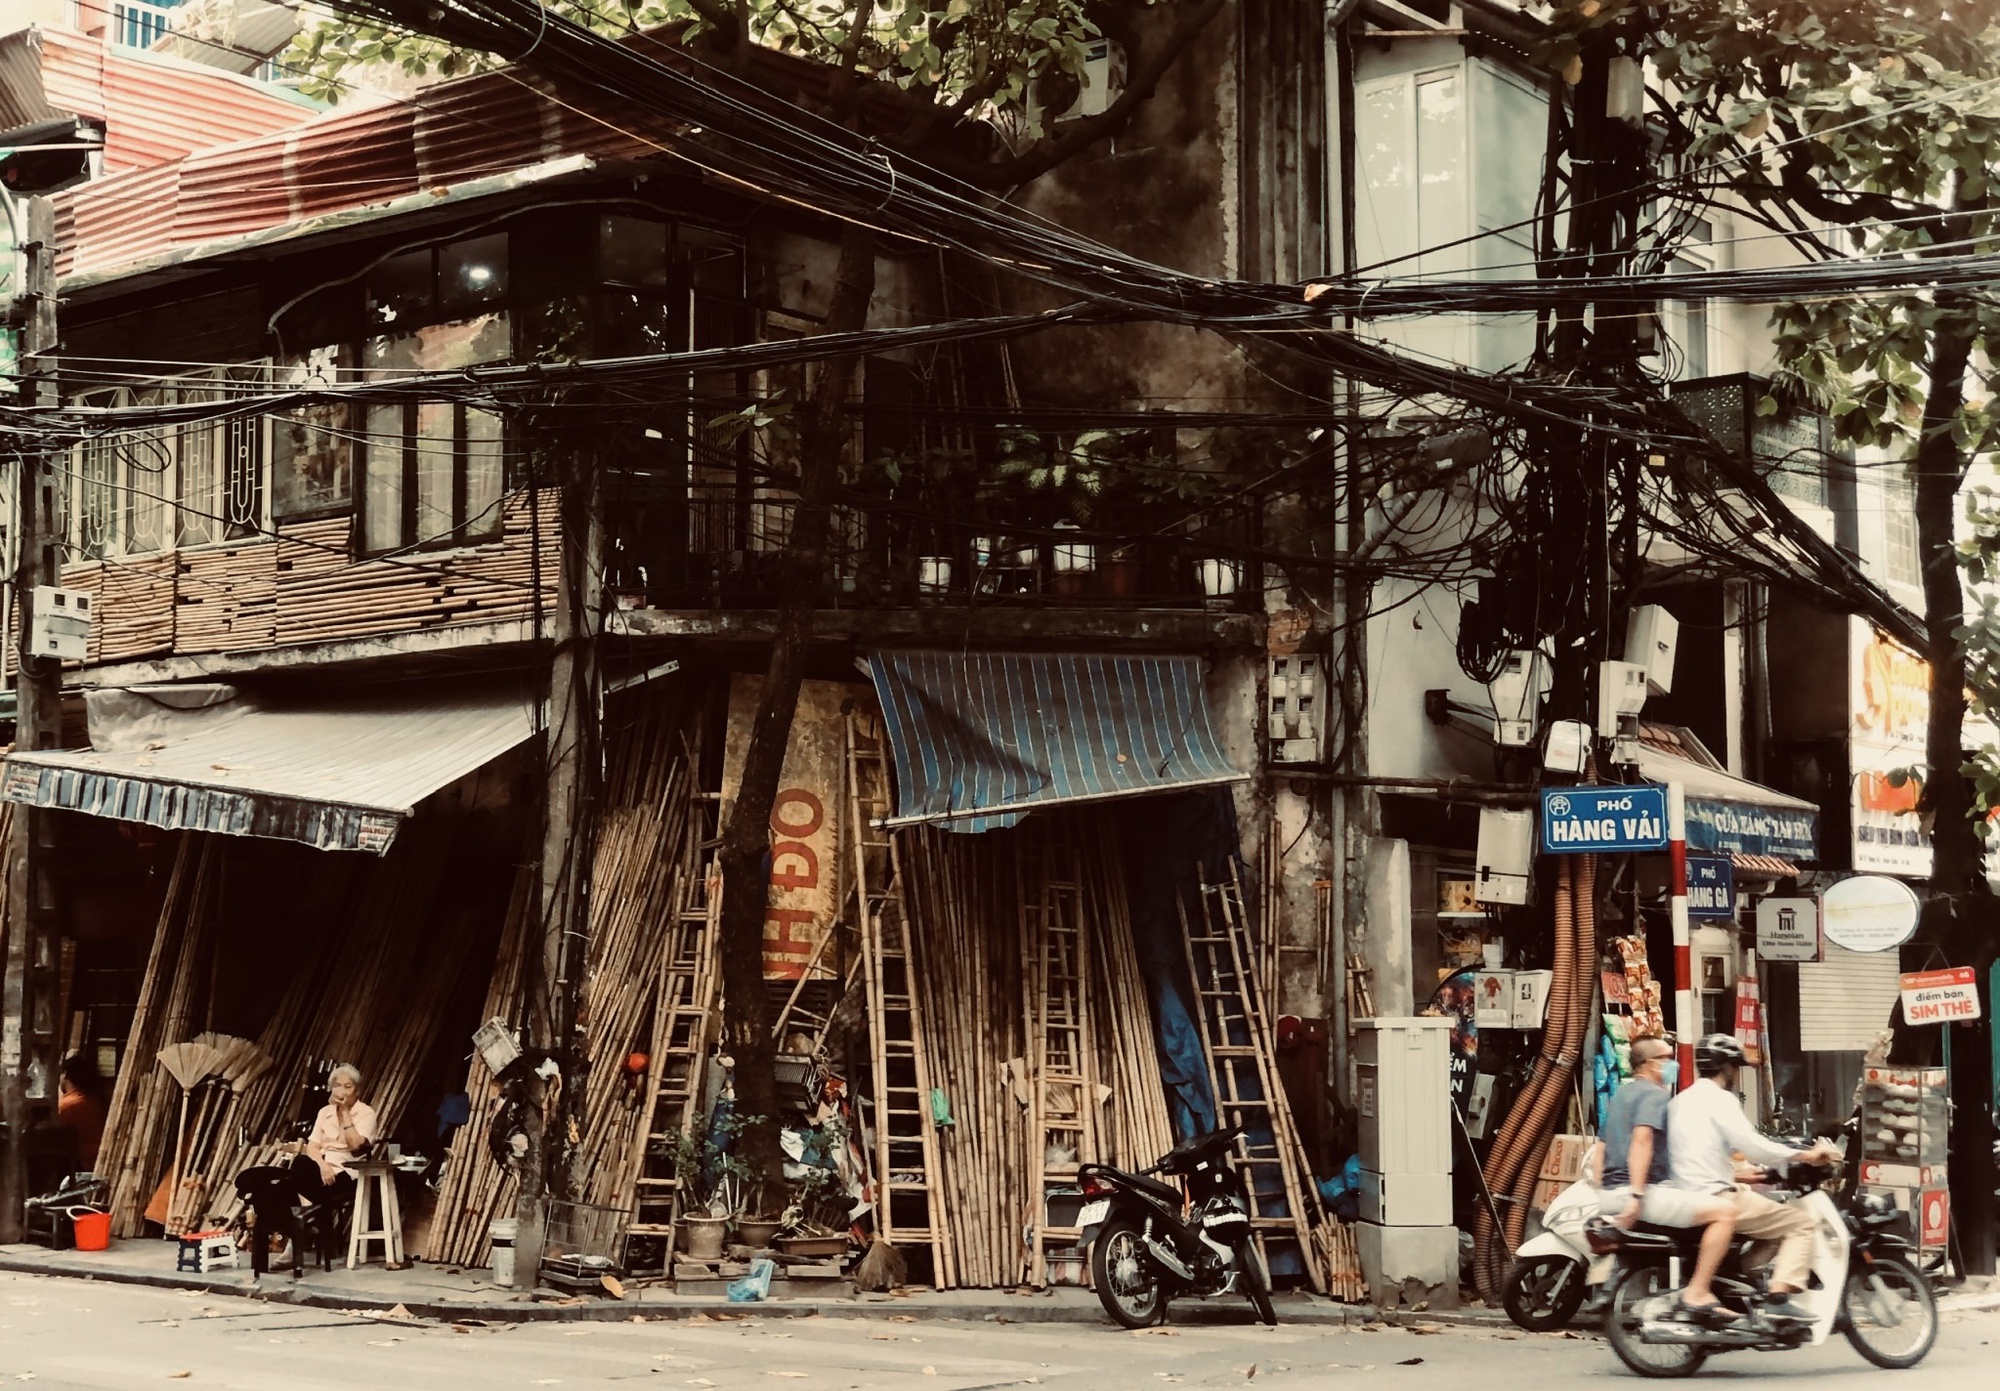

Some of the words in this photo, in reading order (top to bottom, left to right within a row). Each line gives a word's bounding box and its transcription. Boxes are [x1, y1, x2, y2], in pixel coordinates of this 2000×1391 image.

[1597, 795, 1633, 811] PHỐ
[1552, 815, 1616, 842] HÀNG
[1622, 810, 1660, 840] VẢI
[1701, 866, 1717, 880] PHỐ
[1715, 882, 1729, 908] GÀ
[1910, 1004, 1939, 1019] SIM
[1550, 1140, 1563, 1176] Choco
